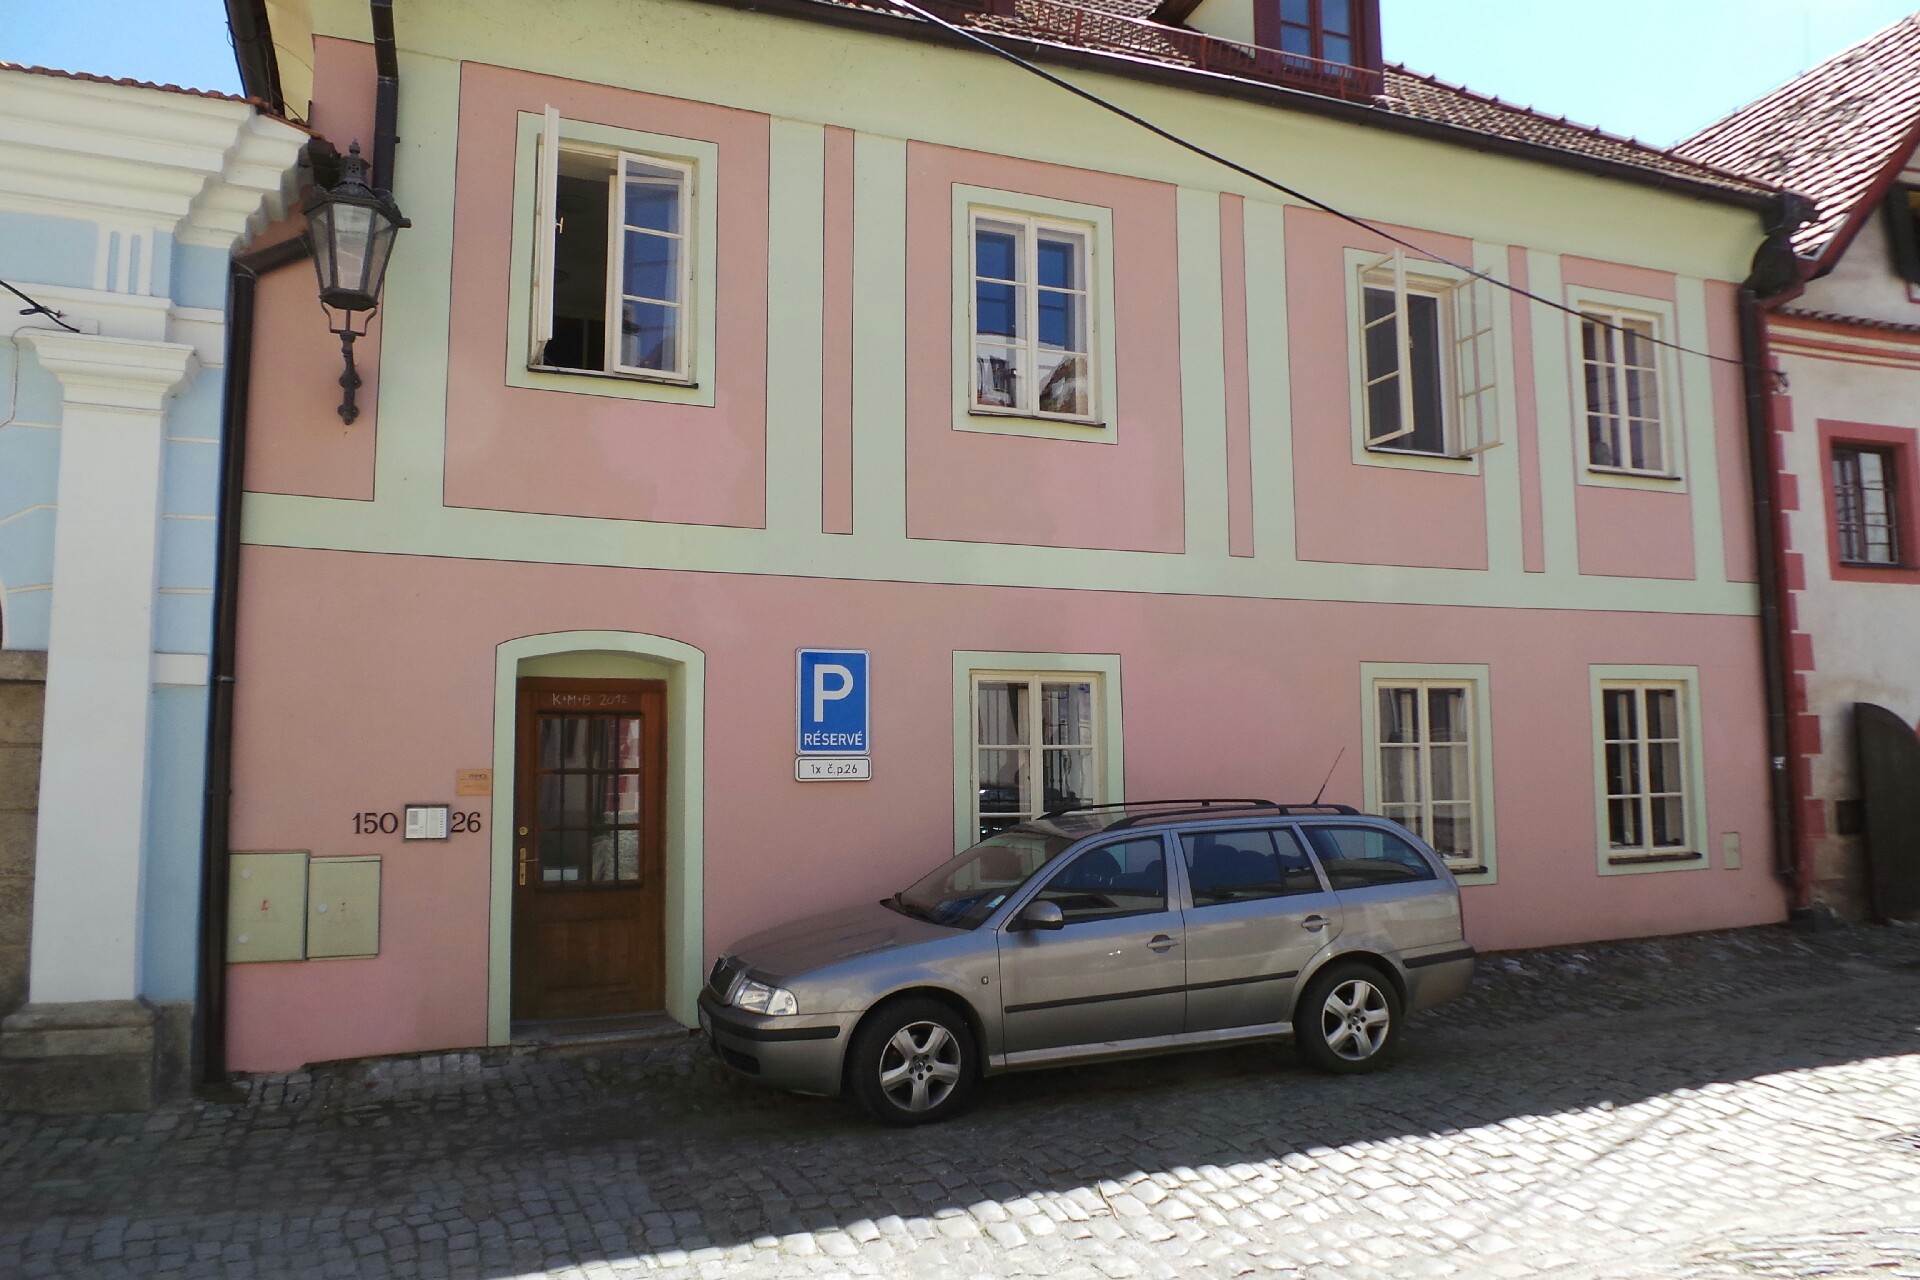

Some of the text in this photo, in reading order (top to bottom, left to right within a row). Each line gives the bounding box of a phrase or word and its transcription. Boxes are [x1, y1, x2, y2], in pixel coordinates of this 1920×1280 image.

[813, 664, 854, 722] P
[804, 730, 863, 745] RÉSERVÉ
[811, 763, 821, 774] 1x
[352, 812, 399, 835] 150
[450, 811, 482, 834] 26
